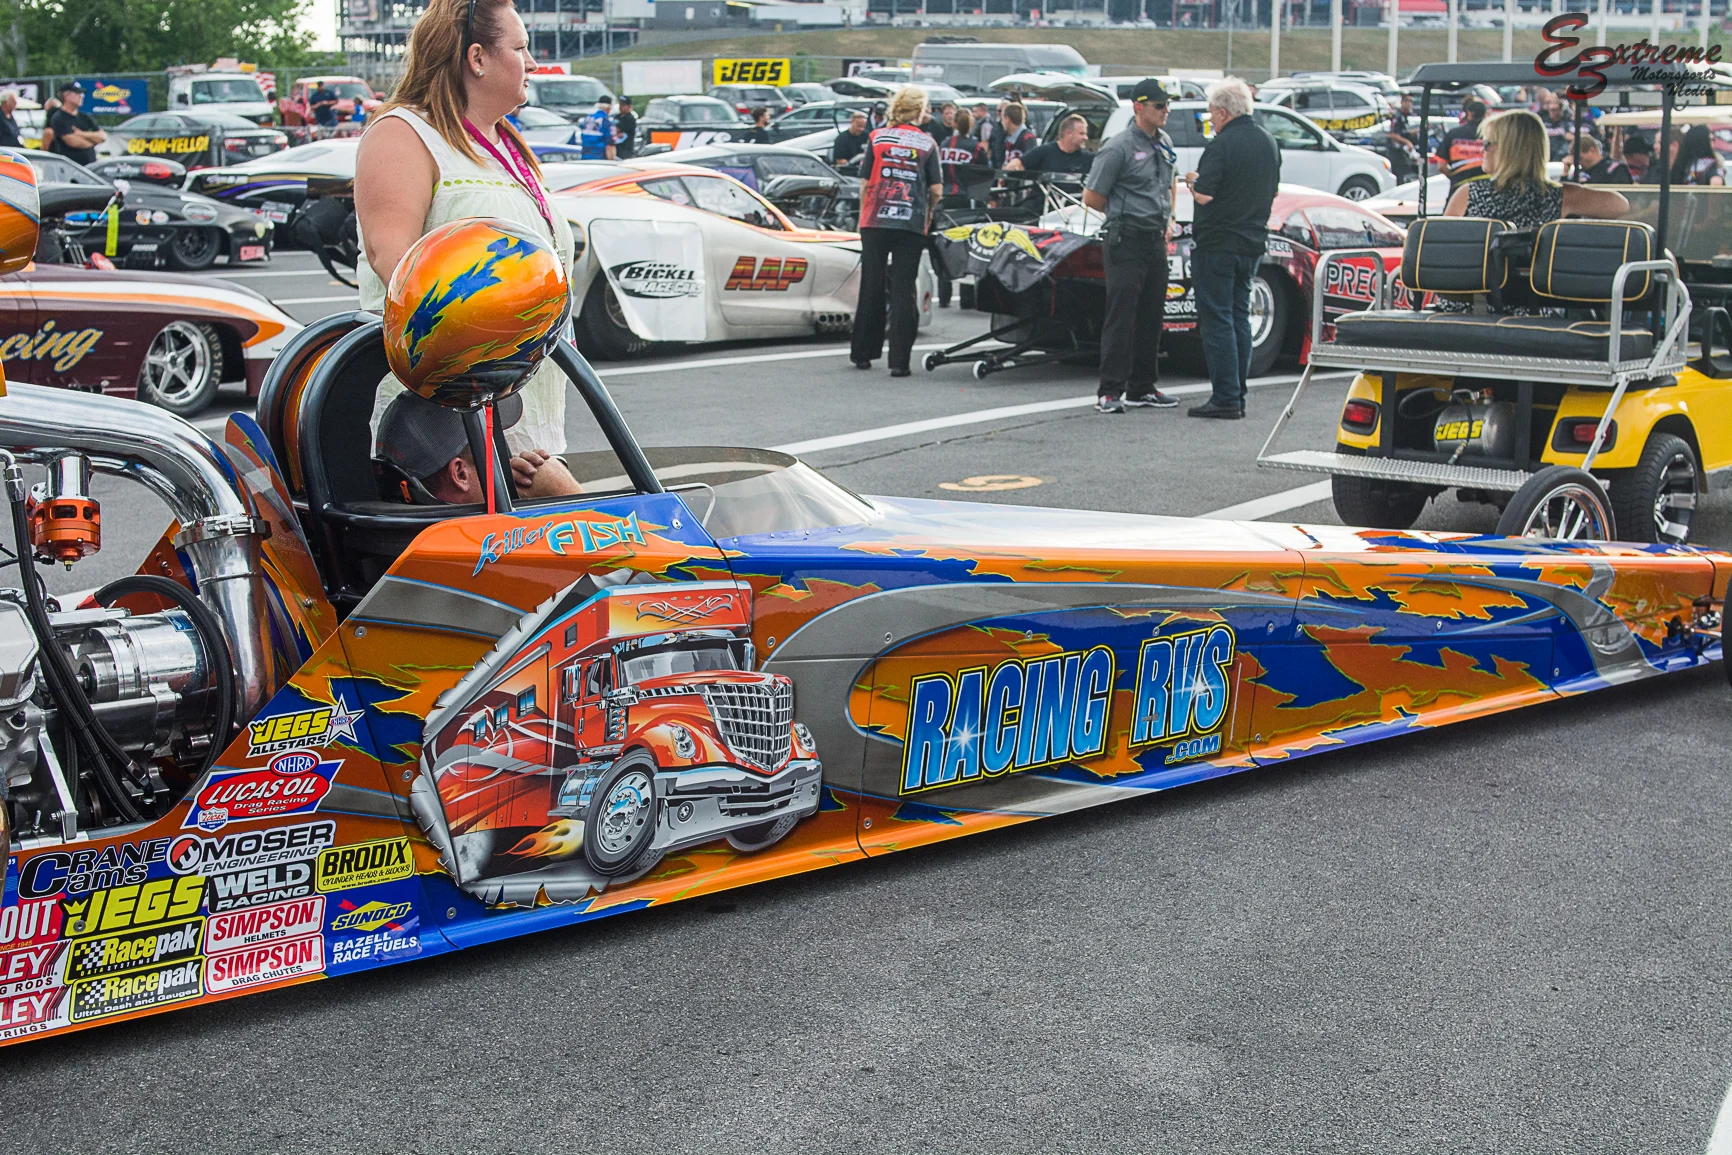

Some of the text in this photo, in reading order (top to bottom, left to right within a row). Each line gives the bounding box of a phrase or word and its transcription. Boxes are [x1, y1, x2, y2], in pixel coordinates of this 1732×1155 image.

[720, 61, 783, 82] JEGS
[624, 266, 696, 280] BICKEL
[634, 280, 674, 293] RACE
[724, 256, 808, 291] AAP
[1435, 419, 1484, 440] JEGS
[546, 511, 647, 555] FISH
[900, 624, 1236, 794] RACING RVS
[251, 709, 333, 746] JEGS
[249, 734, 328, 756] ALLSTARS
[1165, 732, 1222, 764] .COM
[277, 757, 312, 773] NHRA
[206, 776, 318, 805] LUCAS OIL
[234, 796, 308, 811] Drag Racing
[248, 805, 286, 815] Series
[201, 823, 334, 862] MOSER
[202, 846, 320, 873] ENGINEERING
[322, 841, 409, 877] BRODIX
[213, 862, 311, 899] WELD
[322, 874, 354, 886] CYLINDER
[355, 870, 378, 881] HEADS
[385, 864, 410, 876] BLOCKS
[64, 875, 206, 937] JEGS
[216, 885, 310, 911] RACING
[213, 901, 316, 941] SIMPSON
[336, 903, 408, 930] SUNOCO
[101, 923, 200, 966] Racepak
[244, 929, 287, 944] HELMETS
[333, 932, 391, 953] BAZELL
[212, 940, 314, 981] SIMPSON
[333, 936, 417, 965] RACE FUELS
[80, 957, 151, 977] DATA SYSTEMS
[231, 965, 303, 986] DRAG CHUTES
[15, 977, 53, 993] RODS
[104, 962, 200, 1001] Racepak
[74, 988, 198, 1019] Ultra Dash and Gauges
[85, 991, 155, 1010] DATA SYSTEMS
